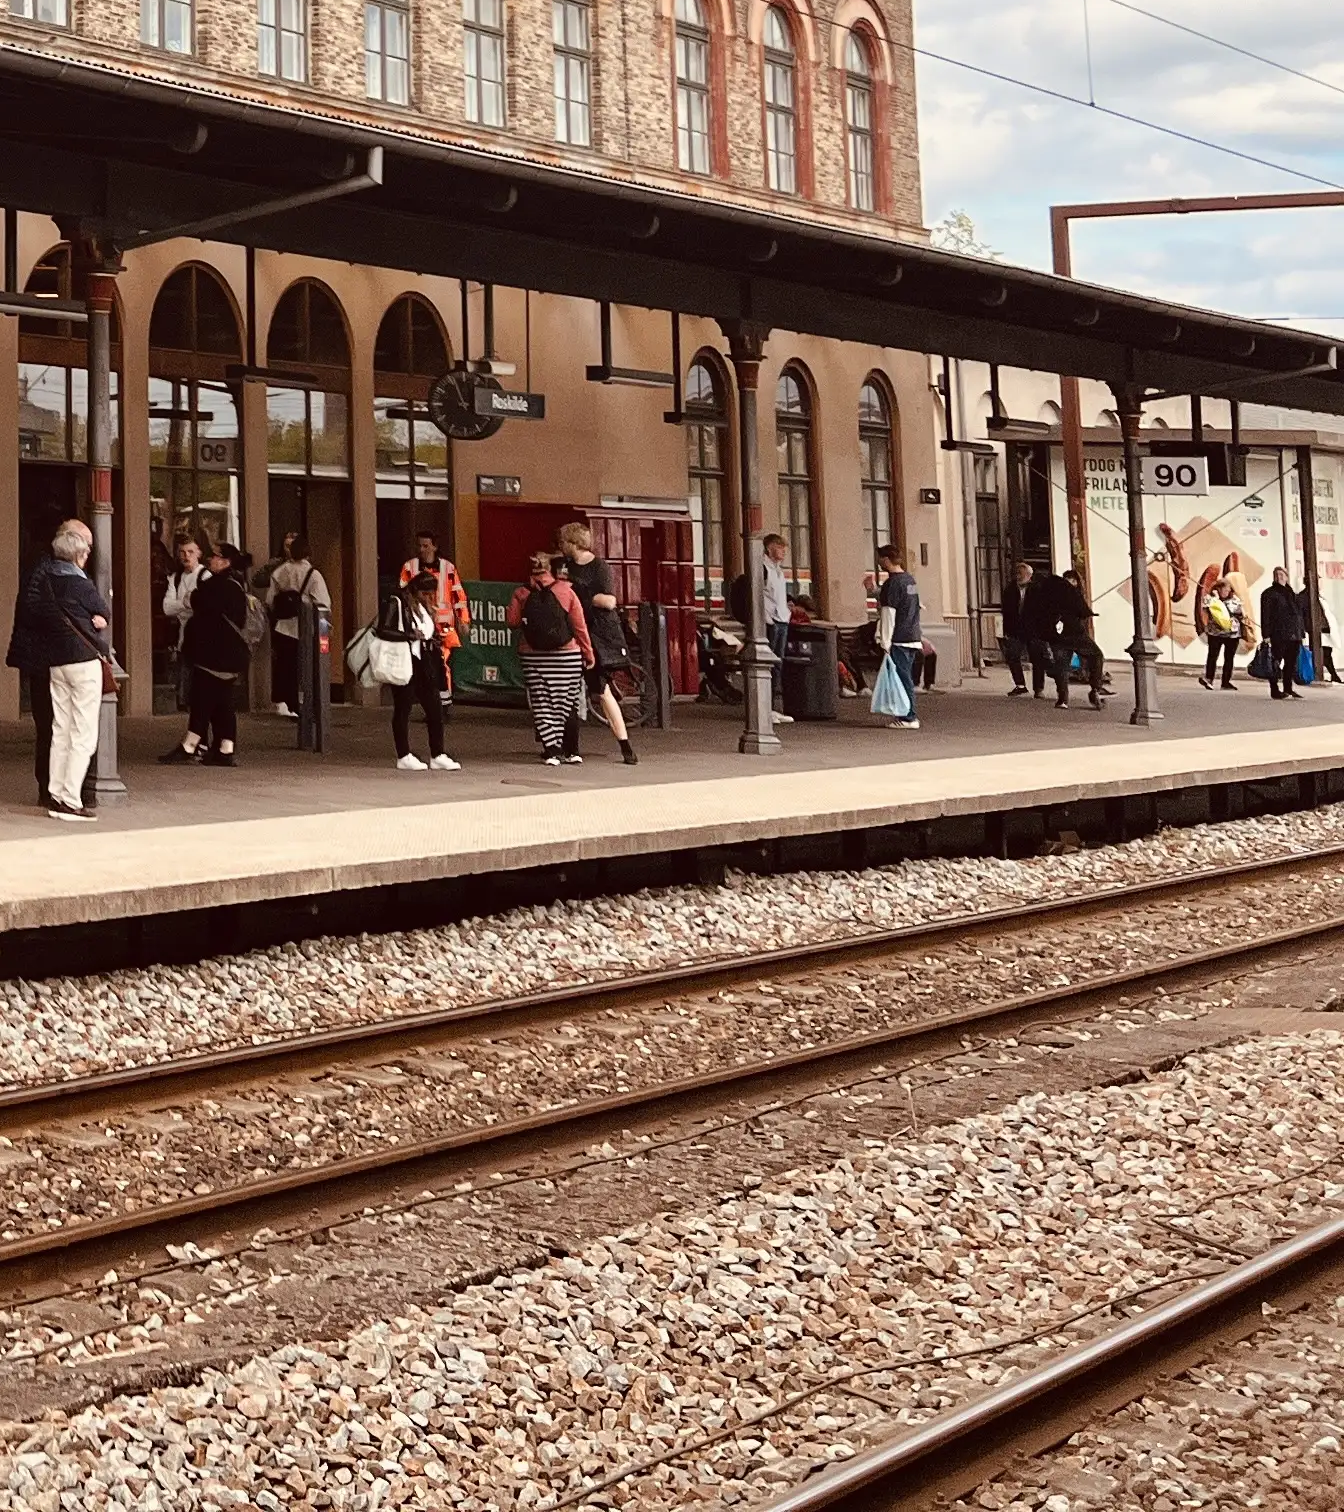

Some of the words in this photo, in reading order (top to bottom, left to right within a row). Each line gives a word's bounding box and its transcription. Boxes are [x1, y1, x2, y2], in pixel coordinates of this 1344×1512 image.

[492, 393, 529, 412] Roskilde
[1084, 459, 1115, 473] TDOG
[1154, 464, 1197, 487] 90
[1085, 477, 1128, 492] FRILAN
[1090, 496, 1126, 510] METE
[470, 600, 483, 621] Vi
[488, 601, 507, 622] ha
[470, 624, 512, 646] åbent
